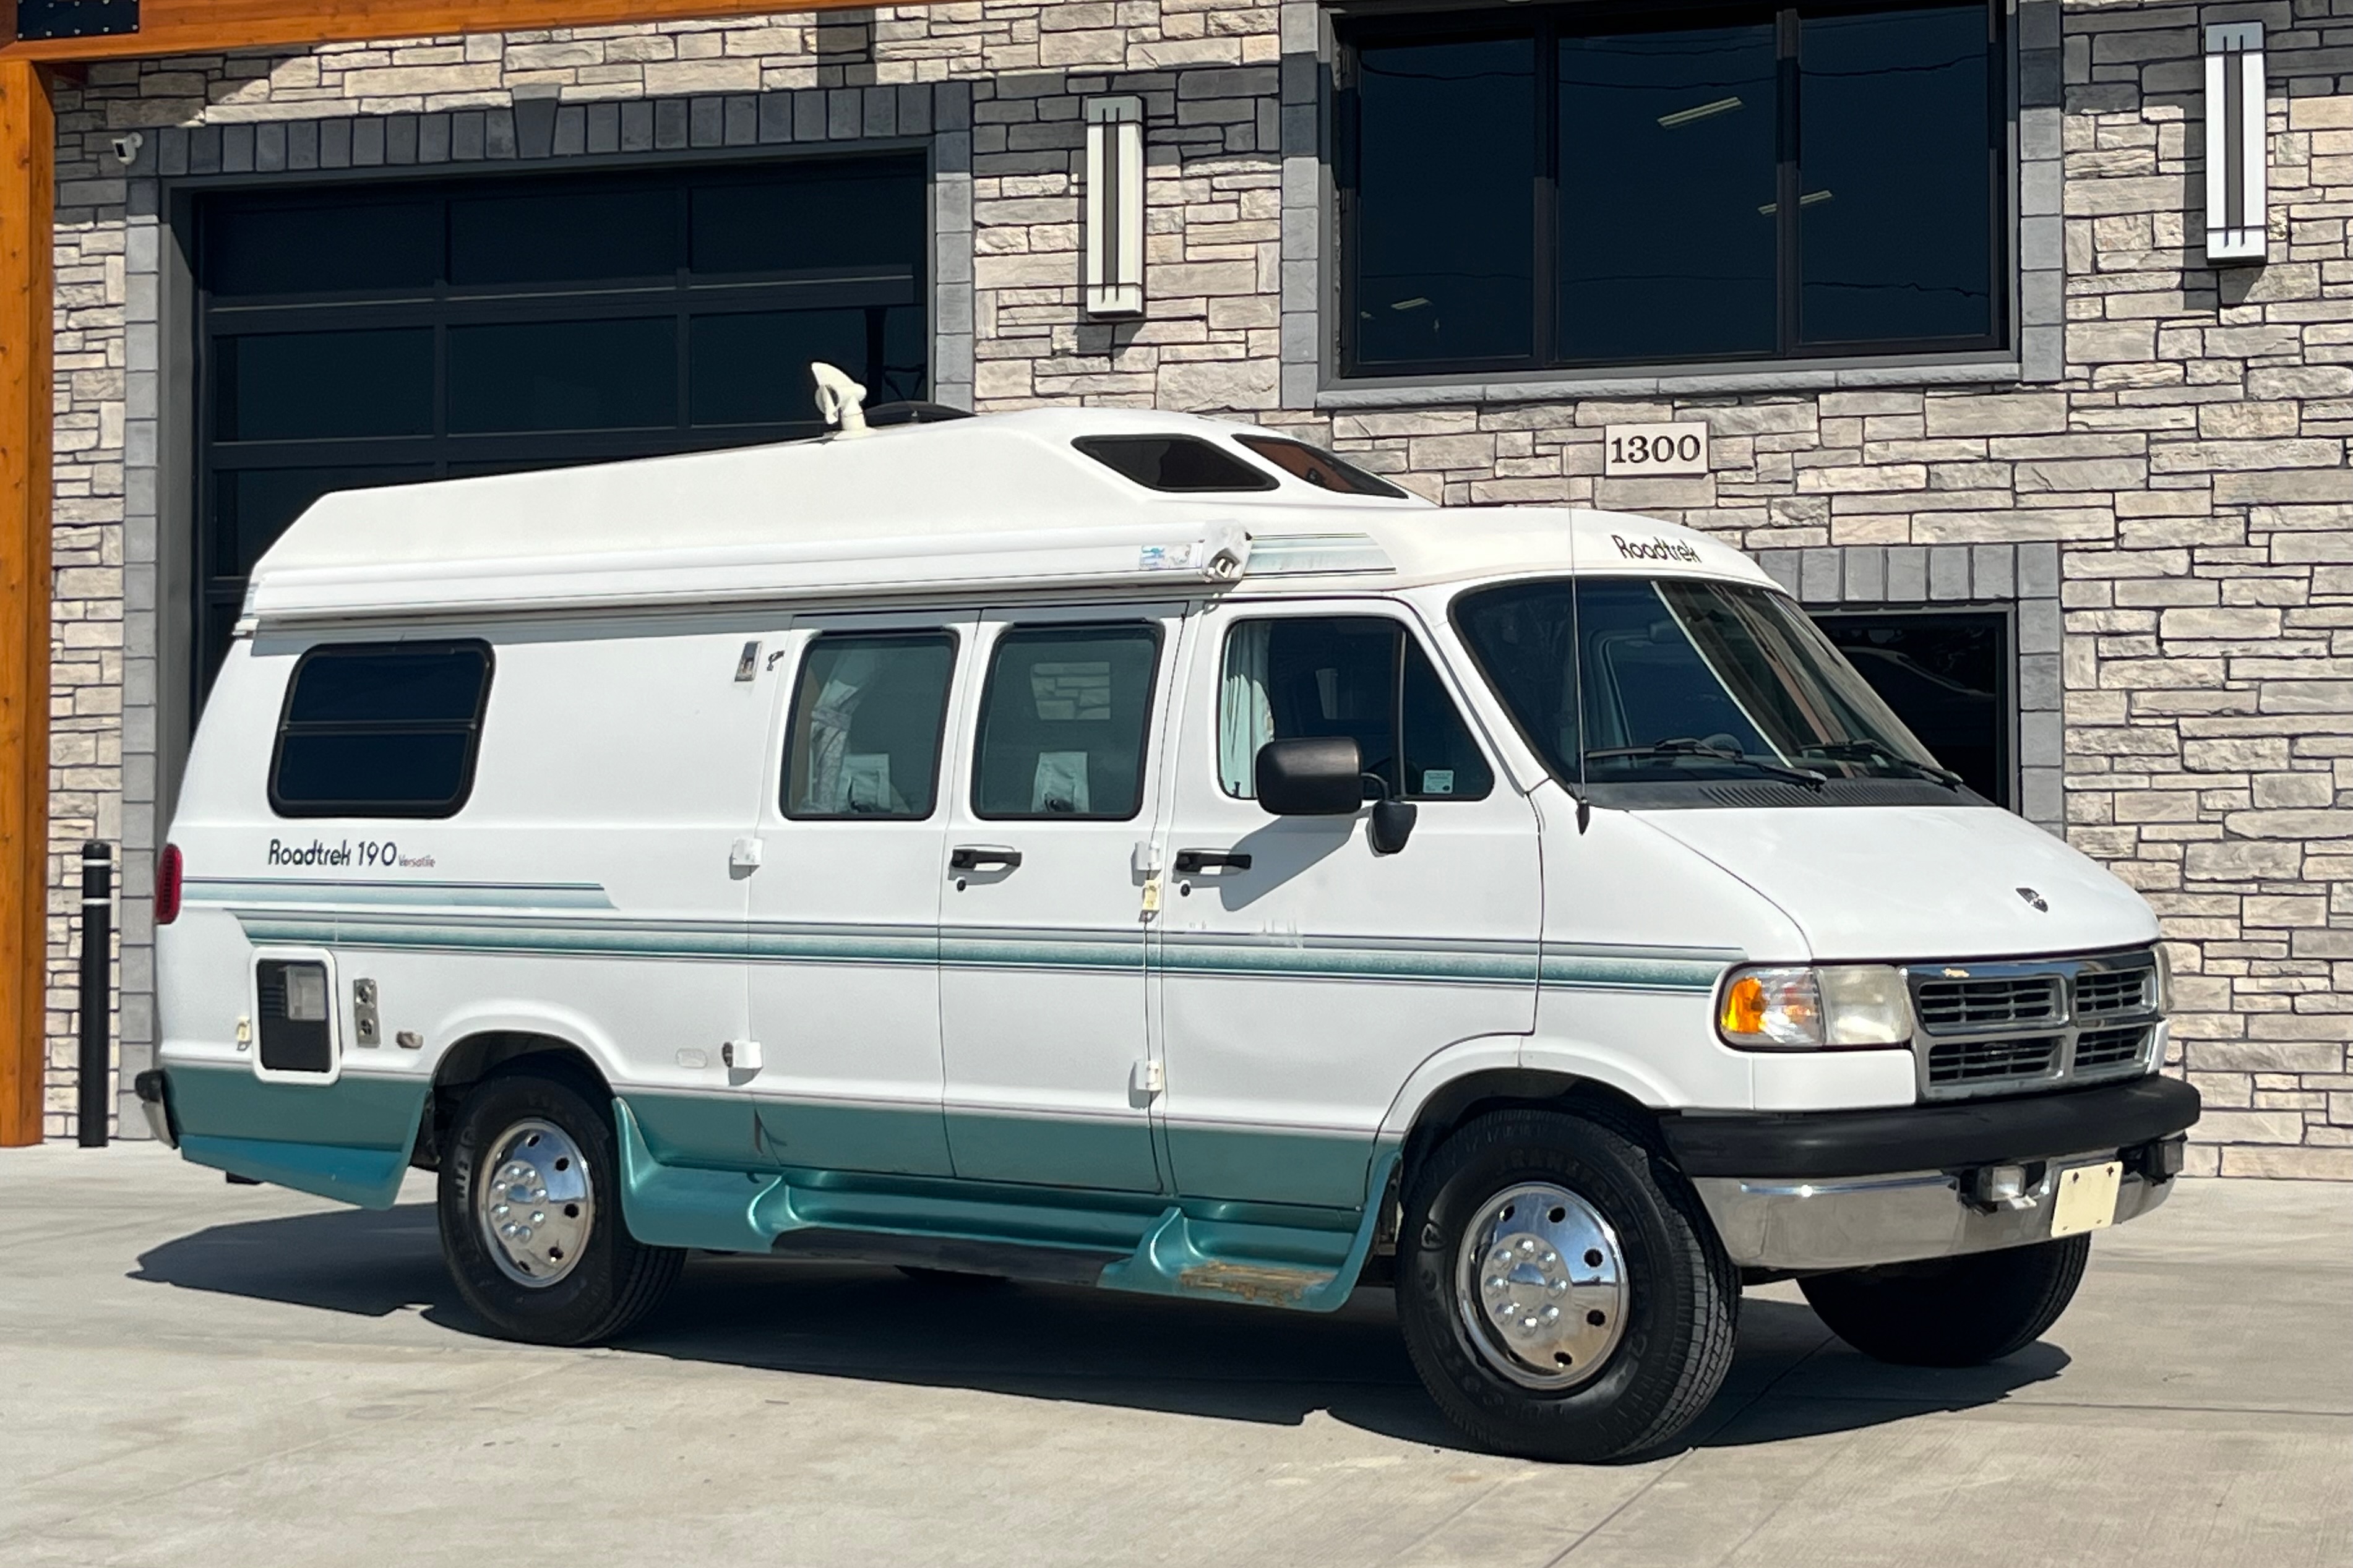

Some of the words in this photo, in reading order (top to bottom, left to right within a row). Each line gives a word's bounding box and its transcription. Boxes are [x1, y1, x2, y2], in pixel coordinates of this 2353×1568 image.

[1611, 434, 1700, 463] 1300
[1611, 534, 1703, 563] Roadtrek
[268, 838, 351, 866] Roadtrek
[358, 841, 397, 867] 190
